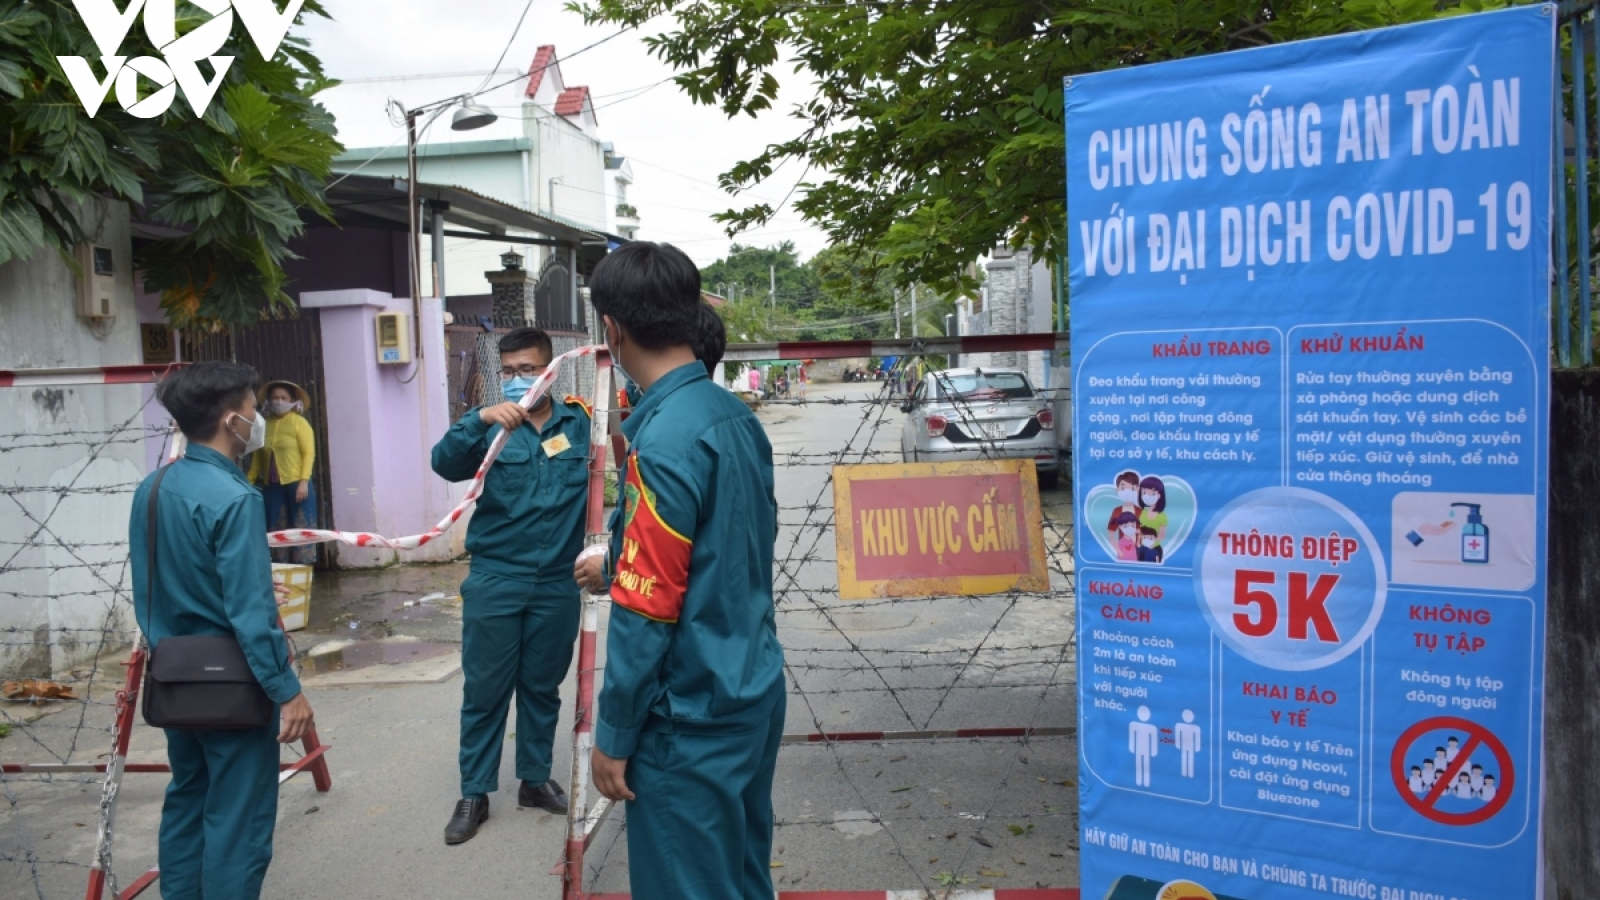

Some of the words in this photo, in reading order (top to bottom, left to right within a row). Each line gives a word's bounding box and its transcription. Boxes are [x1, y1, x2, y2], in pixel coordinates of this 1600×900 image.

[1088, 116, 1207, 190] CHUNG
[1221, 85, 1321, 176] SỐNG
[1336, 94, 1390, 164] AN
[1406, 65, 1520, 156] TOÀN
[1080, 203, 1135, 277] VỚI
[1147, 210, 1205, 285] ĐẠI
[1221, 199, 1310, 281] DỊCH
[1327, 181, 1531, 261] COVID-19
[1152, 335, 1201, 357] KHẨU
[1208, 340, 1271, 356] TRANG
[1301, 332, 1343, 353] KHỬ
[1349, 327, 1424, 352] KHUẨN
[1089, 376, 1113, 387] Đeo
[1116, 372, 1147, 387] khẩu
[1151, 376, 1185, 389] trang
[1189, 373, 1209, 386] vải
[1213, 373, 1261, 388] thường
[1296, 371, 1324, 384] Rửa
[1329, 371, 1352, 386] tay
[1356, 371, 1411, 386] thường
[1415, 370, 1464, 384] xuyên
[1469, 366, 1513, 384] bằng
[1089, 394, 1125, 407] xuyên
[1128, 394, 1144, 407] tại
[1148, 394, 1168, 405] nơi
[1171, 393, 1206, 407] công
[1296, 391, 1315, 404] xà
[1320, 391, 1368, 406] phòng
[1372, 391, 1412, 406] hoặc
[1416, 391, 1458, 405] dung
[1463, 391, 1499, 405] dịch
[1089, 412, 1120, 425] cộng
[1130, 412, 1150, 423] nơi
[1153, 412, 1176, 425] tập
[1179, 412, 1213, 425] trung
[1217, 412, 1253, 425] đông
[1296, 411, 1319, 424] sát
[1323, 408, 1369, 424] khuẩn
[1373, 412, 1401, 425] tay.
[1406, 410, 1427, 426] Vệ
[1431, 411, 1463, 423] sinh
[1468, 411, 1500, 423] các
[1089, 430, 1127, 443] người,
[1131, 431, 1156, 442] đeo
[1159, 427, 1191, 442] khẩu
[1194, 431, 1230, 444] trang
[1233, 433, 1241, 444] y
[1245, 428, 1260, 442] tế
[1296, 431, 1332, 445] mặt/
[1338, 431, 1362, 445] vật
[1366, 432, 1405, 446] dụng
[1410, 432, 1466, 446] thường
[1471, 432, 1521, 446] xuyên
[1089, 448, 1105, 461] tại
[1108, 448, 1124, 458] cơ
[1127, 446, 1142, 458] sở
[1145, 450, 1152, 461] y
[1176, 448, 1200, 460] khu
[1203, 448, 1238, 460] cách
[1241, 449, 1256, 462] ly.
[1296, 450, 1325, 465] tiếp
[1328, 451, 1360, 463] xúc.
[1365, 451, 1392, 464] Giữ
[1396, 451, 1415, 467] vệ
[1419, 452, 1456, 466] sinh,
[1461, 449, 1482, 465] để
[1488, 452, 1519, 465] nhà
[1296, 470, 1325, 482] cửa
[1328, 471, 1372, 485] thông
[1376, 472, 1432, 487] thoáng
[860, 508, 909, 556] KHU
[913, 501, 962, 564] VỰC
[967, 486, 1020, 553] CẤM
[1218, 528, 1293, 559] THÔNG
[1301, 532, 1358, 567] ĐIỆP
[1089, 579, 1164, 600] KHOẢNG
[1101, 604, 1151, 623] CÁCH
[1232, 569, 1341, 643] 5K
[1409, 603, 1492, 626] KHÔNG
[1093, 630, 1139, 647] Khoảng
[1142, 636, 1174, 649] cách
[1413, 632, 1437, 653] TỤ
[1444, 631, 1485, 656] TẬP
[1093, 647, 1111, 659] 2m
[1114, 650, 1125, 660] là
[1129, 652, 1144, 663] an
[1148, 653, 1176, 667] toàn
[1094, 664, 1111, 675] khi
[1114, 666, 1136, 680] tiếp
[1140, 671, 1162, 683] xúc
[1401, 670, 1450, 688] Không
[1455, 675, 1471, 690] tụ
[1476, 676, 1503, 691] tập
[1094, 681, 1112, 692] với
[1115, 685, 1148, 698] người
[1243, 681, 1288, 700] KHAI
[1295, 685, 1337, 705] BÁO
[1094, 698, 1127, 712] khác.
[1406, 690, 1447, 707] đông
[1452, 696, 1496, 710] người
[1271, 710, 1281, 724] Y
[1288, 708, 1311, 728] TẾ
[1227, 730, 1257, 744] Khai
[1262, 734, 1289, 748] báo
[1294, 741, 1301, 751] y
[1305, 739, 1321, 752] tế
[1323, 743, 1353, 757] Trên
[1232, 748, 1258, 765] ứng
[1262, 754, 1297, 770] dụng
[1255, 771, 1278, 785] đặt
[1282, 774, 1309, 790] ứng
[1313, 780, 1350, 797] dụng
[1258, 789, 1320, 808] Bluezone
[1084, 827, 1106, 844] HÃY
[1109, 832, 1129, 851] GIỮ
[1132, 838, 1146, 856] AN
[1150, 841, 1180, 863] TOÀN
[1183, 850, 1209, 869] CHO
[1213, 856, 1237, 876] BẠN
[1242, 858, 1258, 879] VÀ
[1262, 863, 1307, 888] CHÚNG
[1310, 873, 1327, 892] TA
[1331, 878, 1376, 900] TRƯỚC
